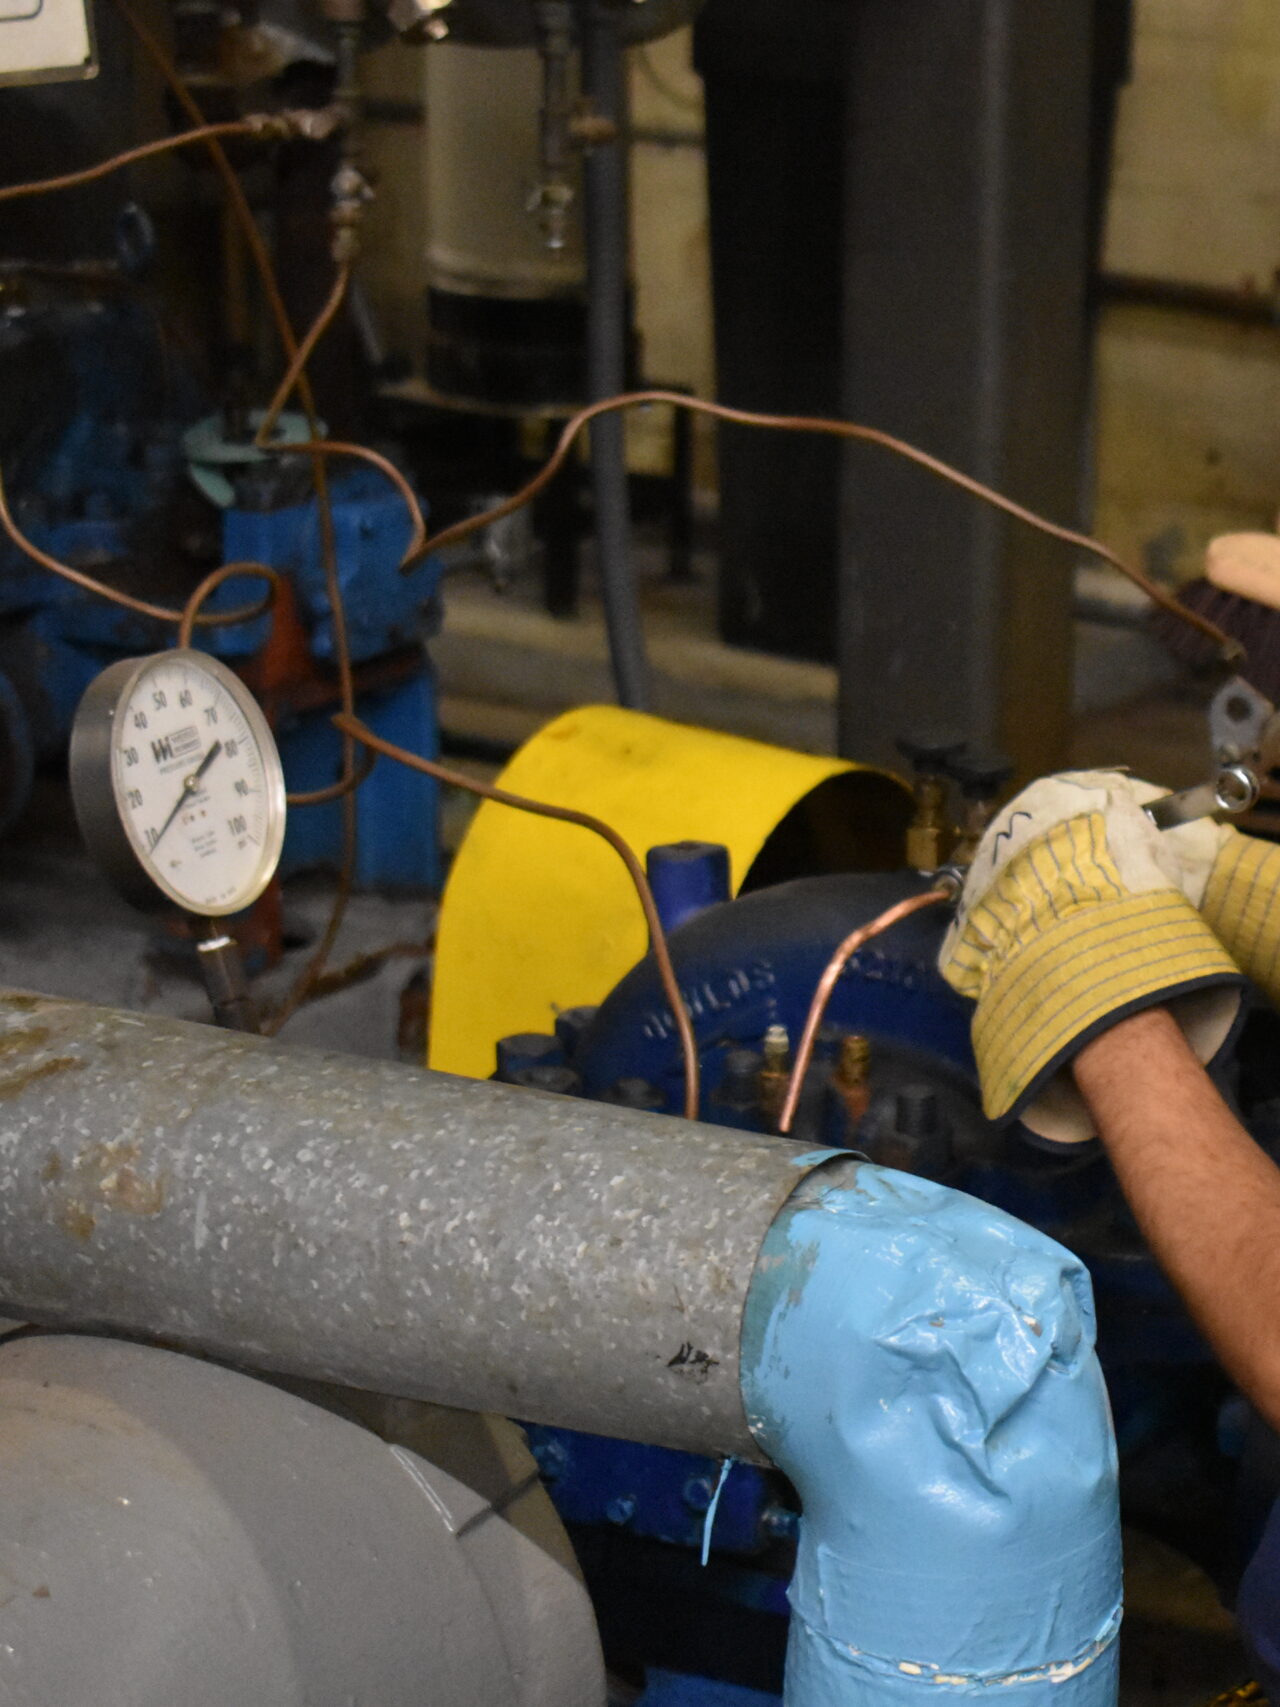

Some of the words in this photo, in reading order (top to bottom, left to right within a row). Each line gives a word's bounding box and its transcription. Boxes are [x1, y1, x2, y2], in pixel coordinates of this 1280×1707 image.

[152, 690, 168, 711] 50
[179, 689, 193, 709] 60
[133, 711, 149, 730] 40
[204, 706, 218, 727] 70
[123, 746, 139, 767] 30
[224, 738, 238, 758] 80
[234, 778, 249, 796] 90
[127, 788, 143, 810] 20
[227, 815, 248, 837] 100
[144, 826, 160, 850] 10
